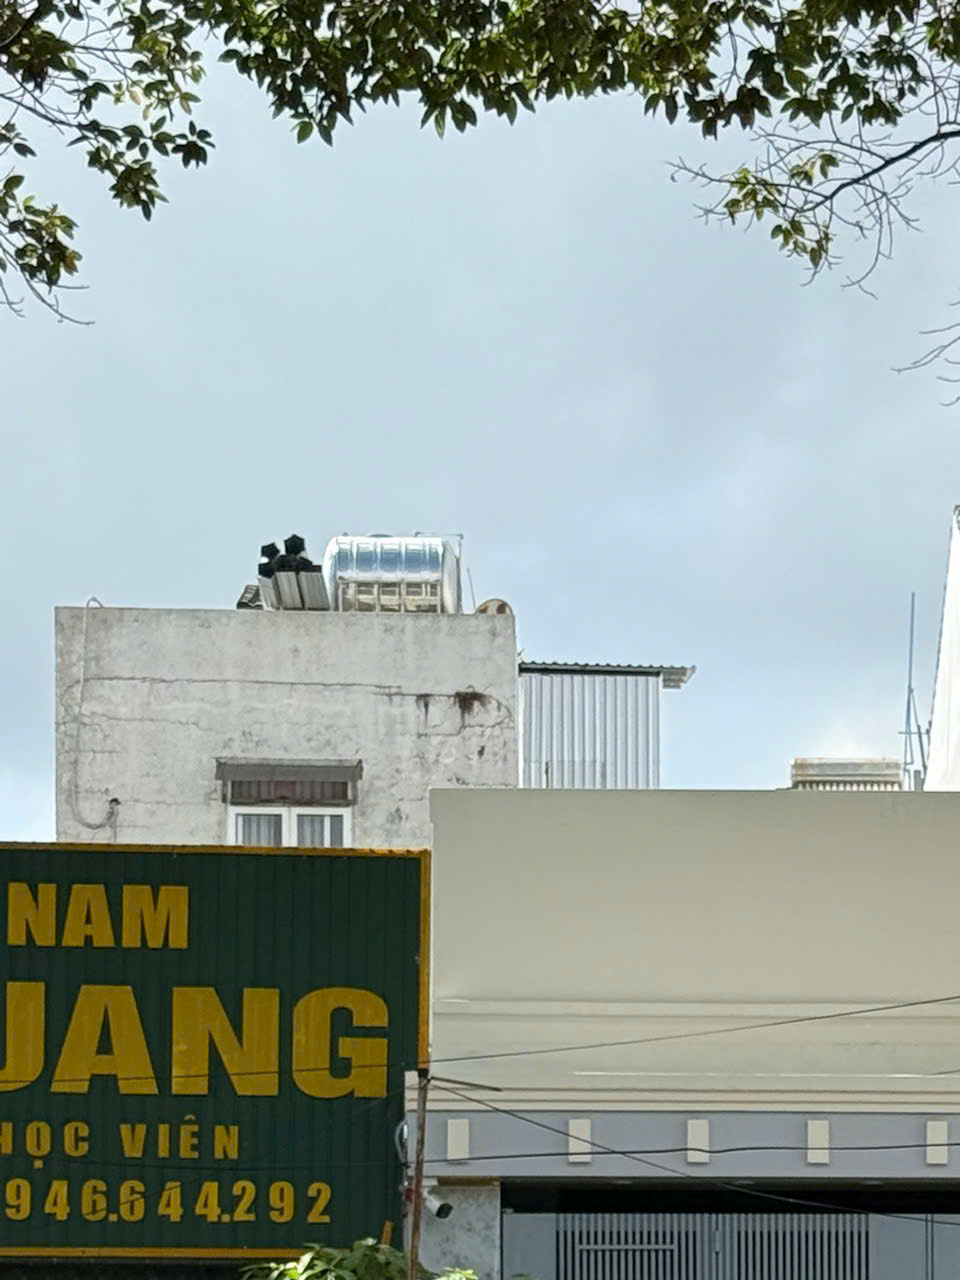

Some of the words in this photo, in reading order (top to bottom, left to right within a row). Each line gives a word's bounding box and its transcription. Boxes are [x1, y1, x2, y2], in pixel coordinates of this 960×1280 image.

[7, 882, 189, 948] NAM
[120, 1114, 239, 1159] VIÊN
[5, 1178, 332, 1223] 946.644.292
